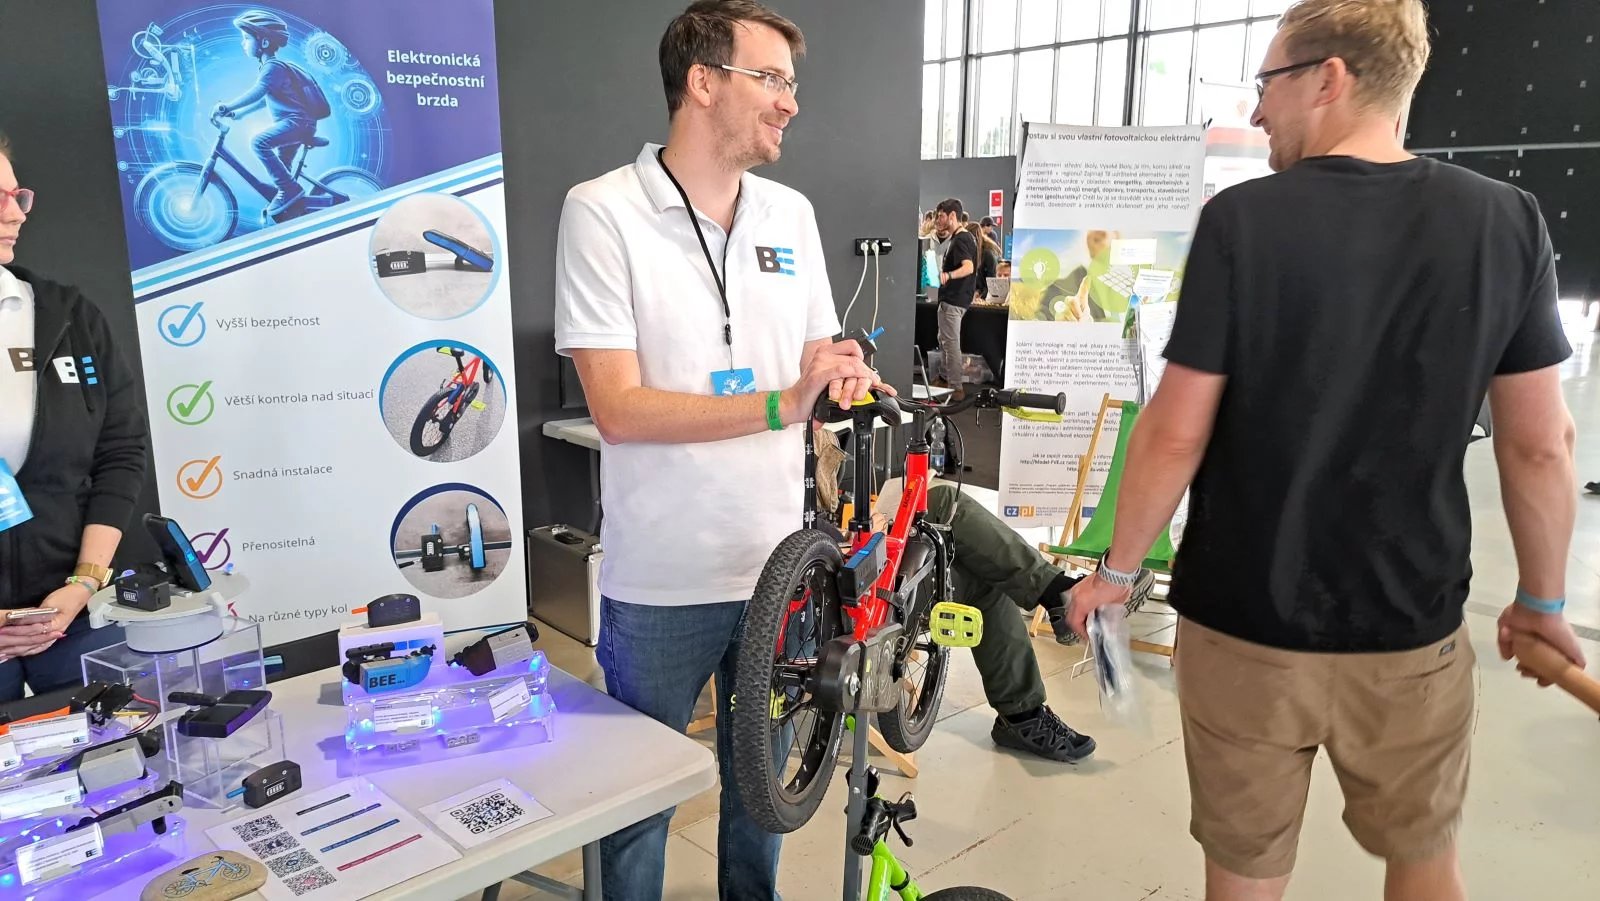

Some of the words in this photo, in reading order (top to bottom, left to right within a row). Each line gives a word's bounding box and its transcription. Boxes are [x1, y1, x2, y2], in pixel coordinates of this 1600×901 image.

[387, 49, 481, 67] Elektronická
[386, 70, 485, 88] bezpečnostní
[416, 92, 459, 107] brzda
[1027, 132, 1049, 140] ostav
[1058, 132, 1076, 141] svou
[1077, 133, 1102, 141] vlastní
[1104, 133, 1159, 142] fotovoltaickou
[1160, 133, 1201, 142] elektrárnu
[215, 316, 248, 331] Vyšší
[250, 315, 321, 330] bezpečnost
[224, 393, 256, 406] Větší
[257, 392, 308, 405] kontrola
[311, 391, 334, 402] nad
[336, 388, 374, 401] situací
[232, 467, 279, 481] Snadná
[281, 465, 333, 477] instalace
[242, 535, 315, 552] Přenositelná
[248, 613, 265, 623] Na
[267, 608, 301, 622] různé
[303, 608, 328, 620] typy
[330, 602, 348, 615] kol
[368, 673, 398, 689] BEE
